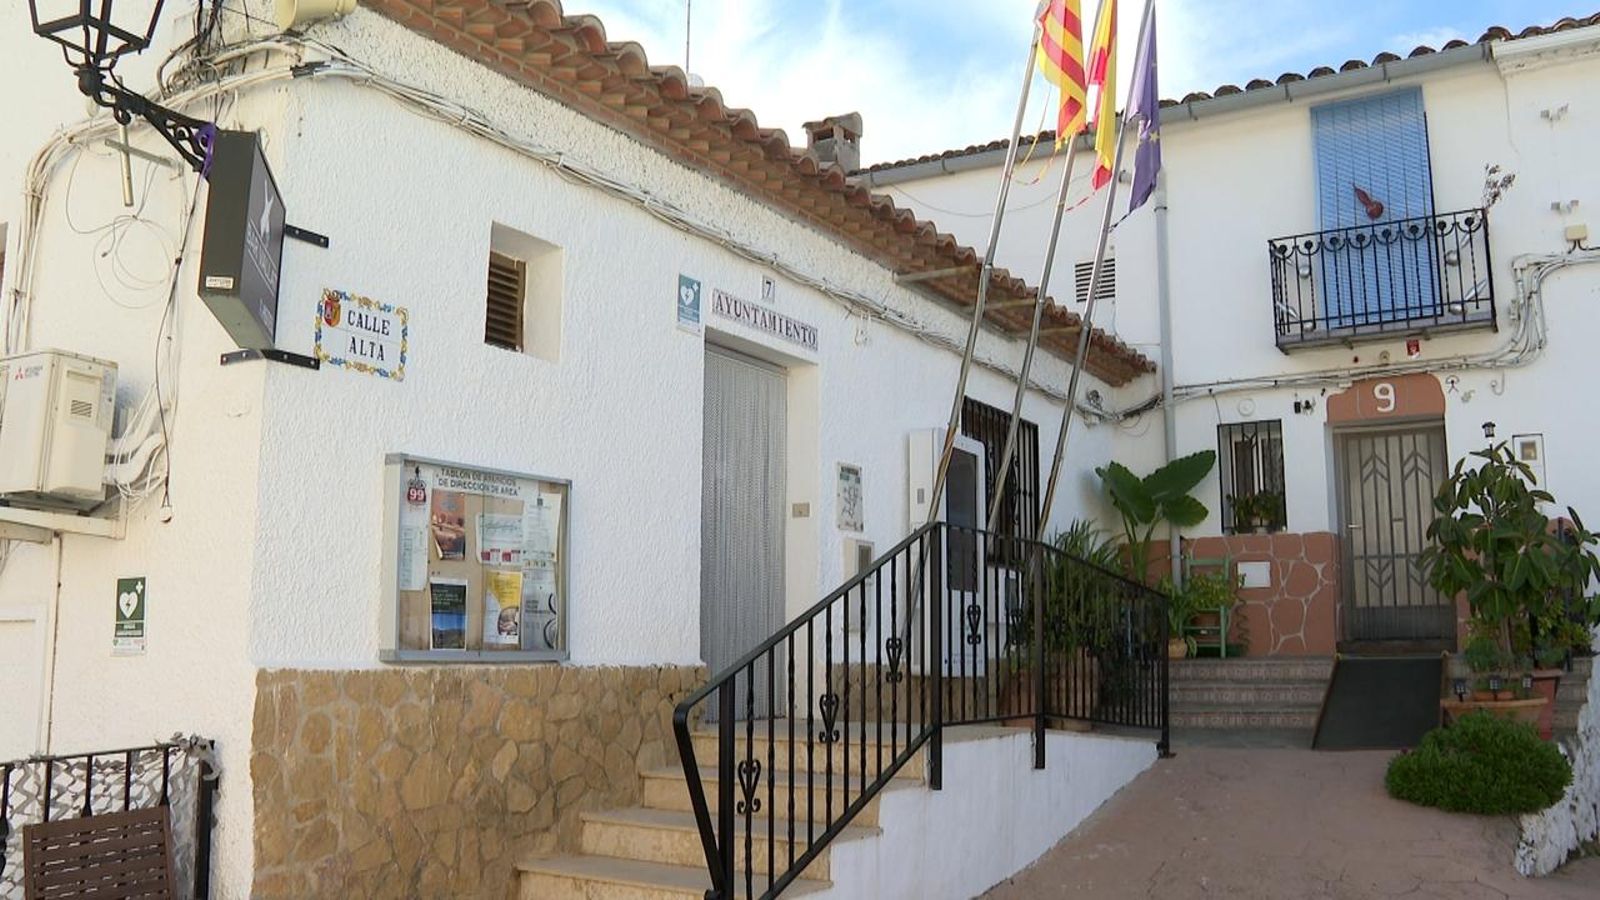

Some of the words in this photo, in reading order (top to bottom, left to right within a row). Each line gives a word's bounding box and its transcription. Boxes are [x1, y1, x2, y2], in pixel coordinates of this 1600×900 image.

[765, 281, 772, 298] 7
[347, 309, 391, 336] CALLE
[715, 293, 816, 347] AYUNTAMIENTO
[349, 335, 385, 361] ALTA
[1373, 383, 1396, 412] 9
[409, 487, 425, 502] 99
[438, 477, 448, 487] DE
